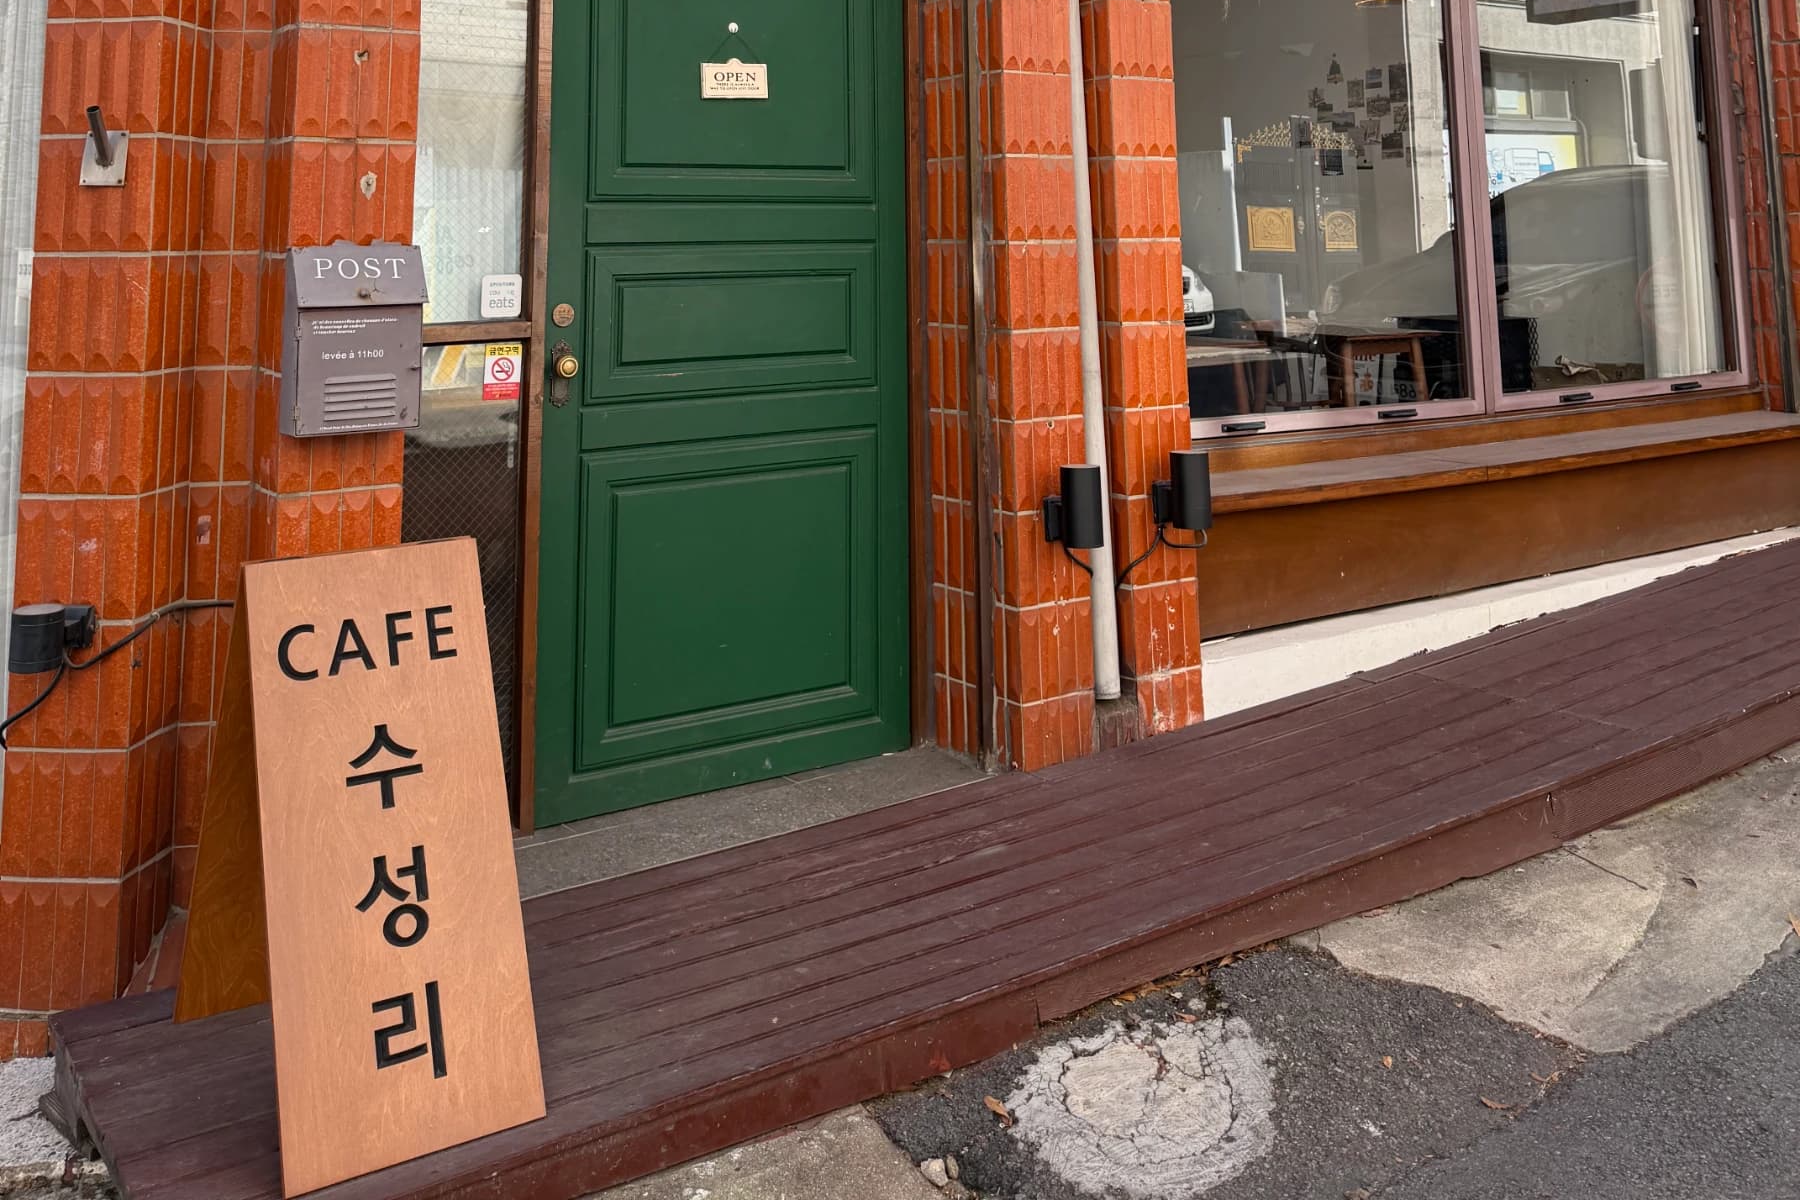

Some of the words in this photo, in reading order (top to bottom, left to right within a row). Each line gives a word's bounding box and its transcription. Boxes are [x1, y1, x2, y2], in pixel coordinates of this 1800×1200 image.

[714, 71, 757, 82] OPEN
[312, 257, 406, 280] POST
[489, 296, 515, 309] eats
[357, 349, 384, 358] 11h00
[489, 346, 519, 356] 금연구역
[277, 605, 458, 681] CAFE
[346, 724, 448, 1079] 수성리
